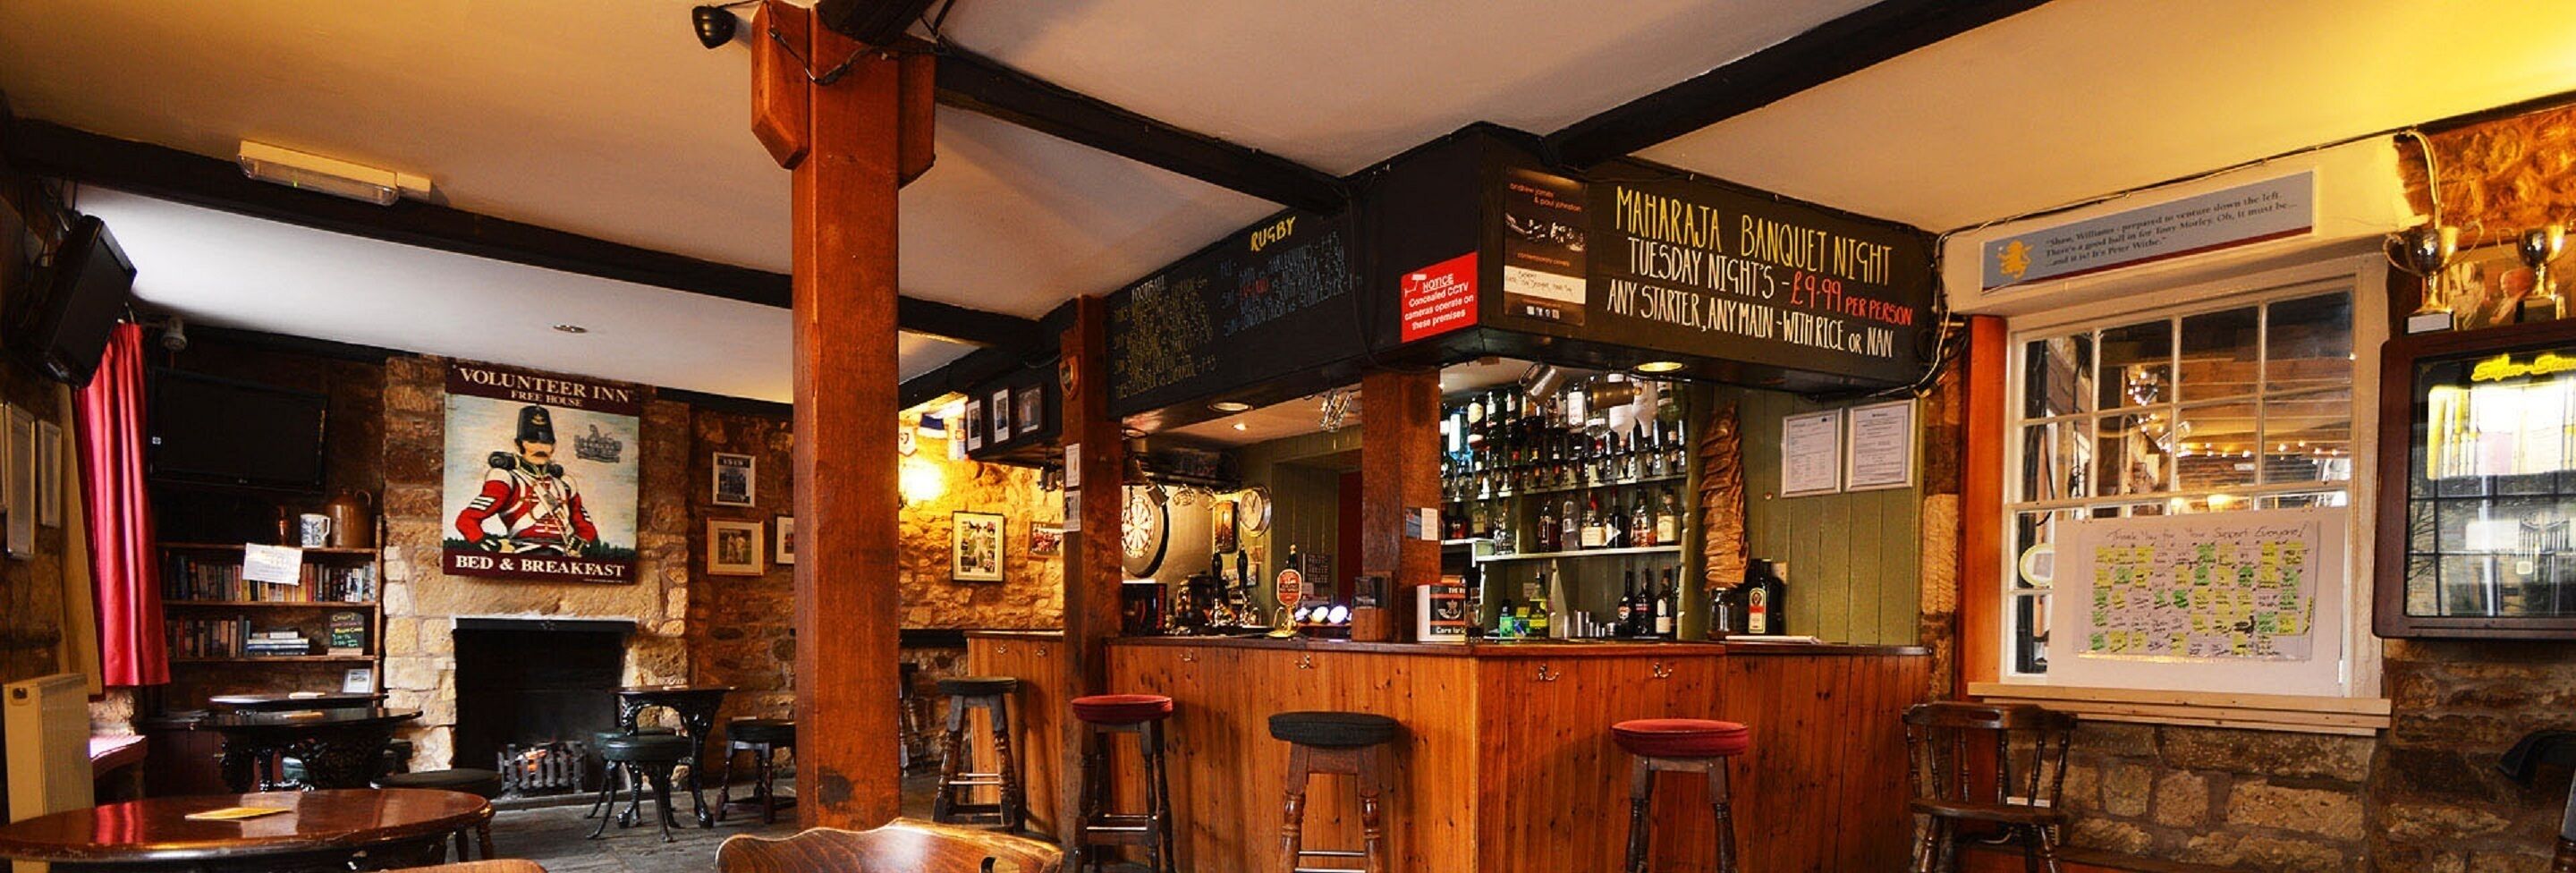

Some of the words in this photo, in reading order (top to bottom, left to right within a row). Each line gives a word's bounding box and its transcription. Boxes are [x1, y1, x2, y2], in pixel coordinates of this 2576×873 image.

[2085, 239, 2106, 250] good
[2108, 234, 2124, 244] ball
[2139, 229, 2151, 238] for
[2248, 206, 2273, 216] must
[2122, 216, 2162, 233] prepared
[2176, 207, 2211, 219] venture
[2214, 201, 2241, 212] down
[2243, 196, 2259, 206] the
[1250, 216, 1296, 251] RUGBY
[1616, 186, 1723, 252] MAHARAJA
[1742, 215, 1827, 273] BANQUET
[1834, 236, 1893, 285] NIGHT
[2108, 244, 2130, 255] Peter
[1409, 289, 1446, 308] Concealed
[1448, 282, 1469, 296] CCTV
[1423, 273, 1453, 292] NOTICE
[1628, 237, 1701, 285] TUESDAY
[1707, 253, 1775, 300] NIGHT'S
[1845, 297, 1866, 318] PER
[1868, 301, 1913, 326] PERSON
[1404, 306, 1434, 321] cameras
[1435, 298, 1462, 312] operate
[1463, 294, 1474, 304] on
[1433, 309, 1465, 326] premises
[1607, 278, 1637, 315] ANY
[1707, 297, 1736, 333] ANY
[1739, 303, 1773, 339] MAIN
[1816, 316, 1844, 351] RICE
[1867, 327, 1894, 358] NAN
[460, 368, 587, 398] VOLUNTEER
[594, 386, 629, 403] INN
[511, 390, 542, 403] FREE
[547, 394, 581, 407] HOUSE
[455, 555, 494, 571] BED
[499, 557, 514, 572] &
[521, 559, 625, 578] BREAKFAST
